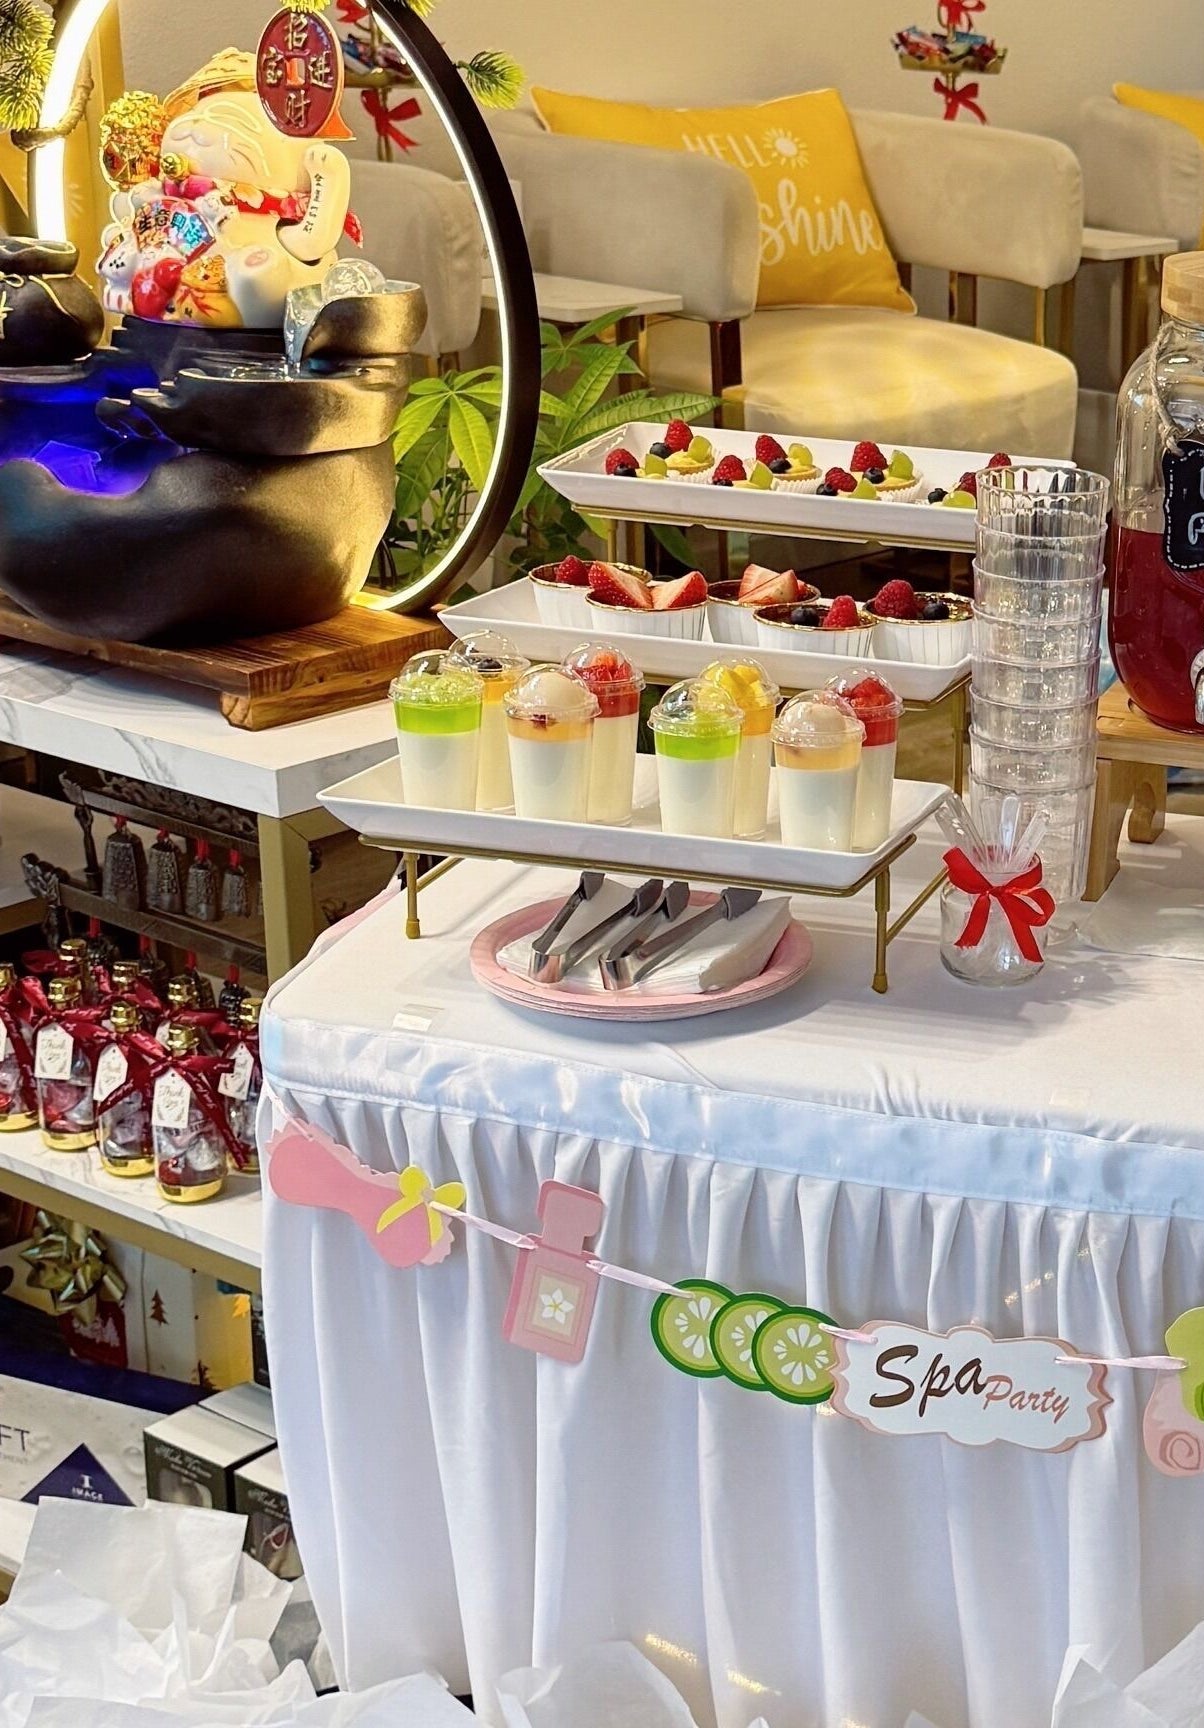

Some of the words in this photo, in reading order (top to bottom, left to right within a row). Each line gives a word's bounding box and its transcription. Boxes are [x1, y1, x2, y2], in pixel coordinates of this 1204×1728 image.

[759, 178, 884, 266] shine
[869, 1344, 987, 1418] Spa
[983, 1374, 1070, 1424] Party
